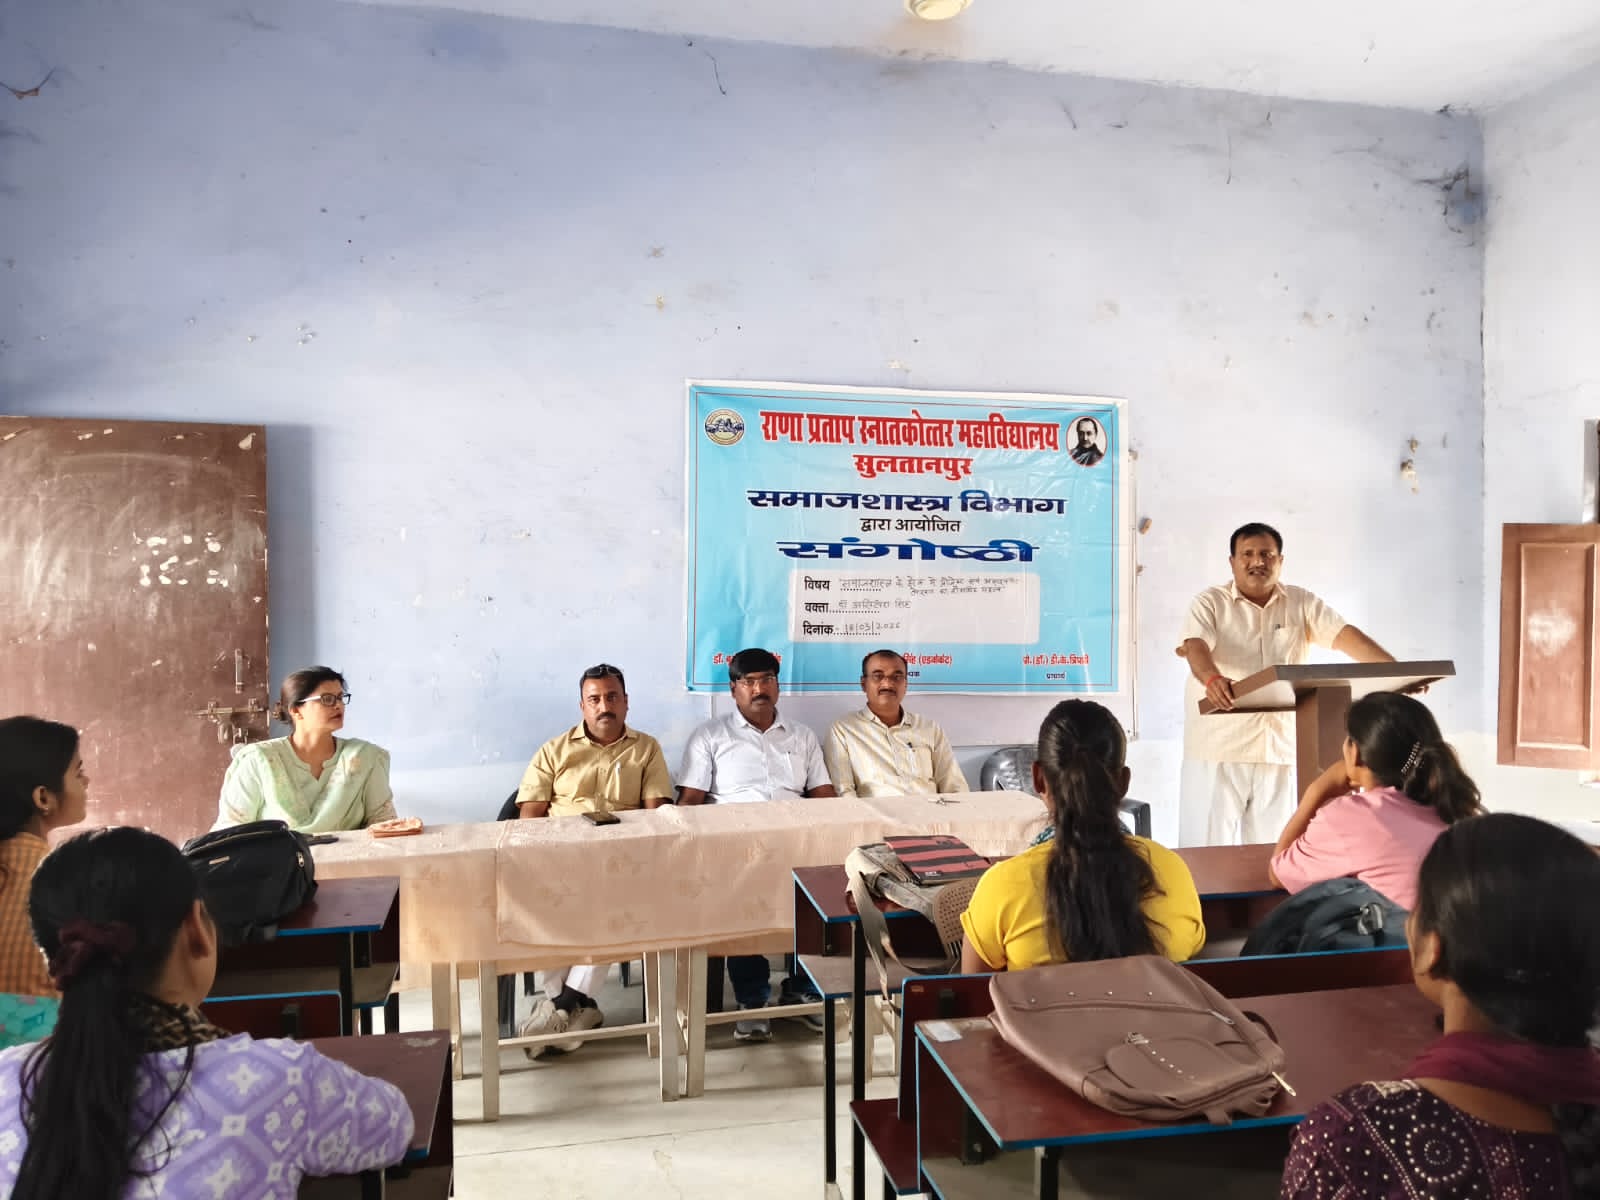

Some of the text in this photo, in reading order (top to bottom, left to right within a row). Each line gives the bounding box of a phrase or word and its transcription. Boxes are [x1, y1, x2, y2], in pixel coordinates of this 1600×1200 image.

[759, 409, 1060, 451] राणा प्रताप स्नातकोत्तर महाविद्यालय
[853, 454, 974, 481] सुलतानपुर
[746, 489, 1067, 514] समाजशास्त्र विभाग
[859, 515, 962, 533] द्वारा आयोजित
[775, 536, 1040, 562] संगोष्ठी
[803, 575, 831, 591] विषय
